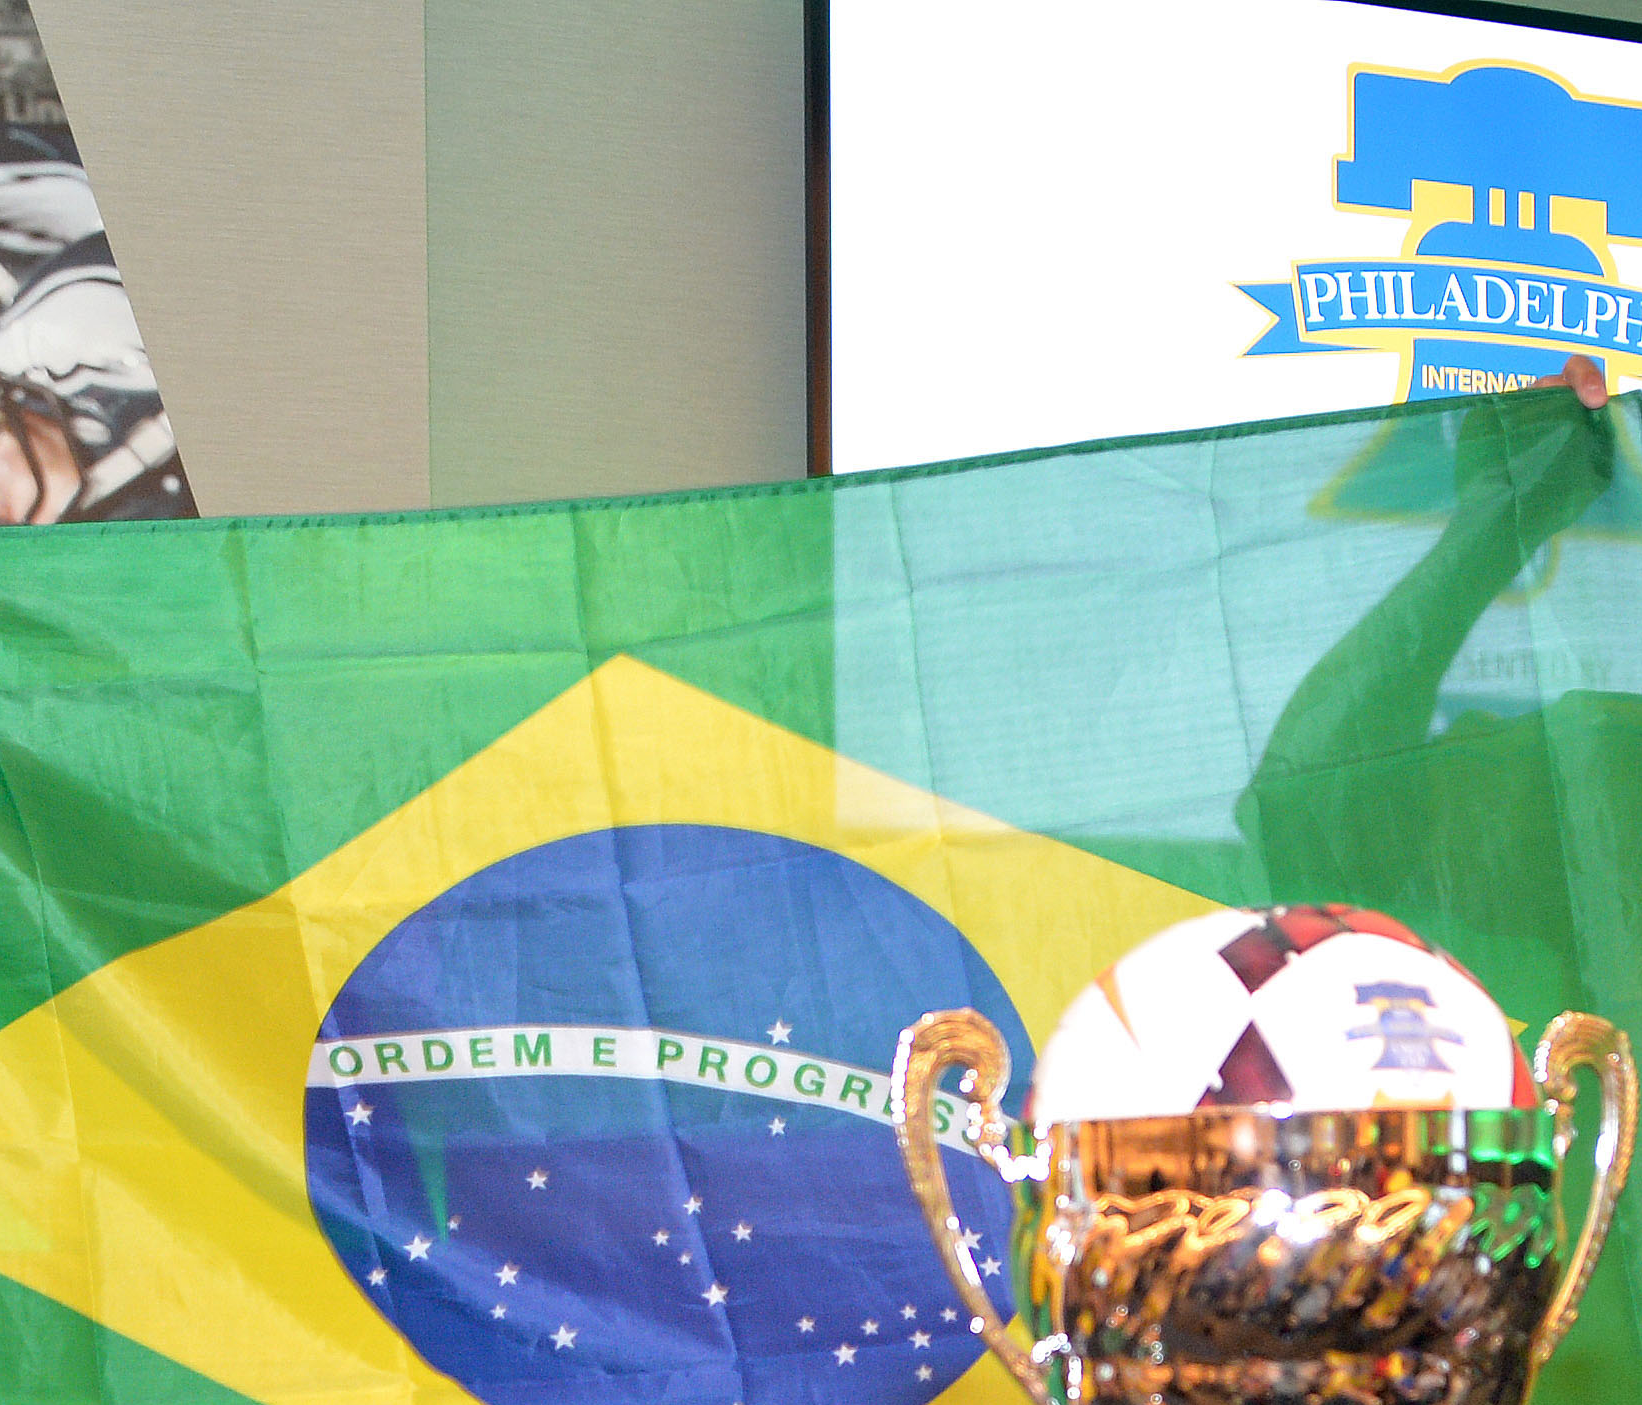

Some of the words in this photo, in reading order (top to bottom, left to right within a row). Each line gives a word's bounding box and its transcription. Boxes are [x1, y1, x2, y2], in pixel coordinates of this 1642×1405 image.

[1421, 364, 1537, 395] INTERNAT
[329, 1033, 553, 1077] ORDEM
[593, 1037, 617, 1068] E
[656, 1037, 975, 1147] PROGRS
